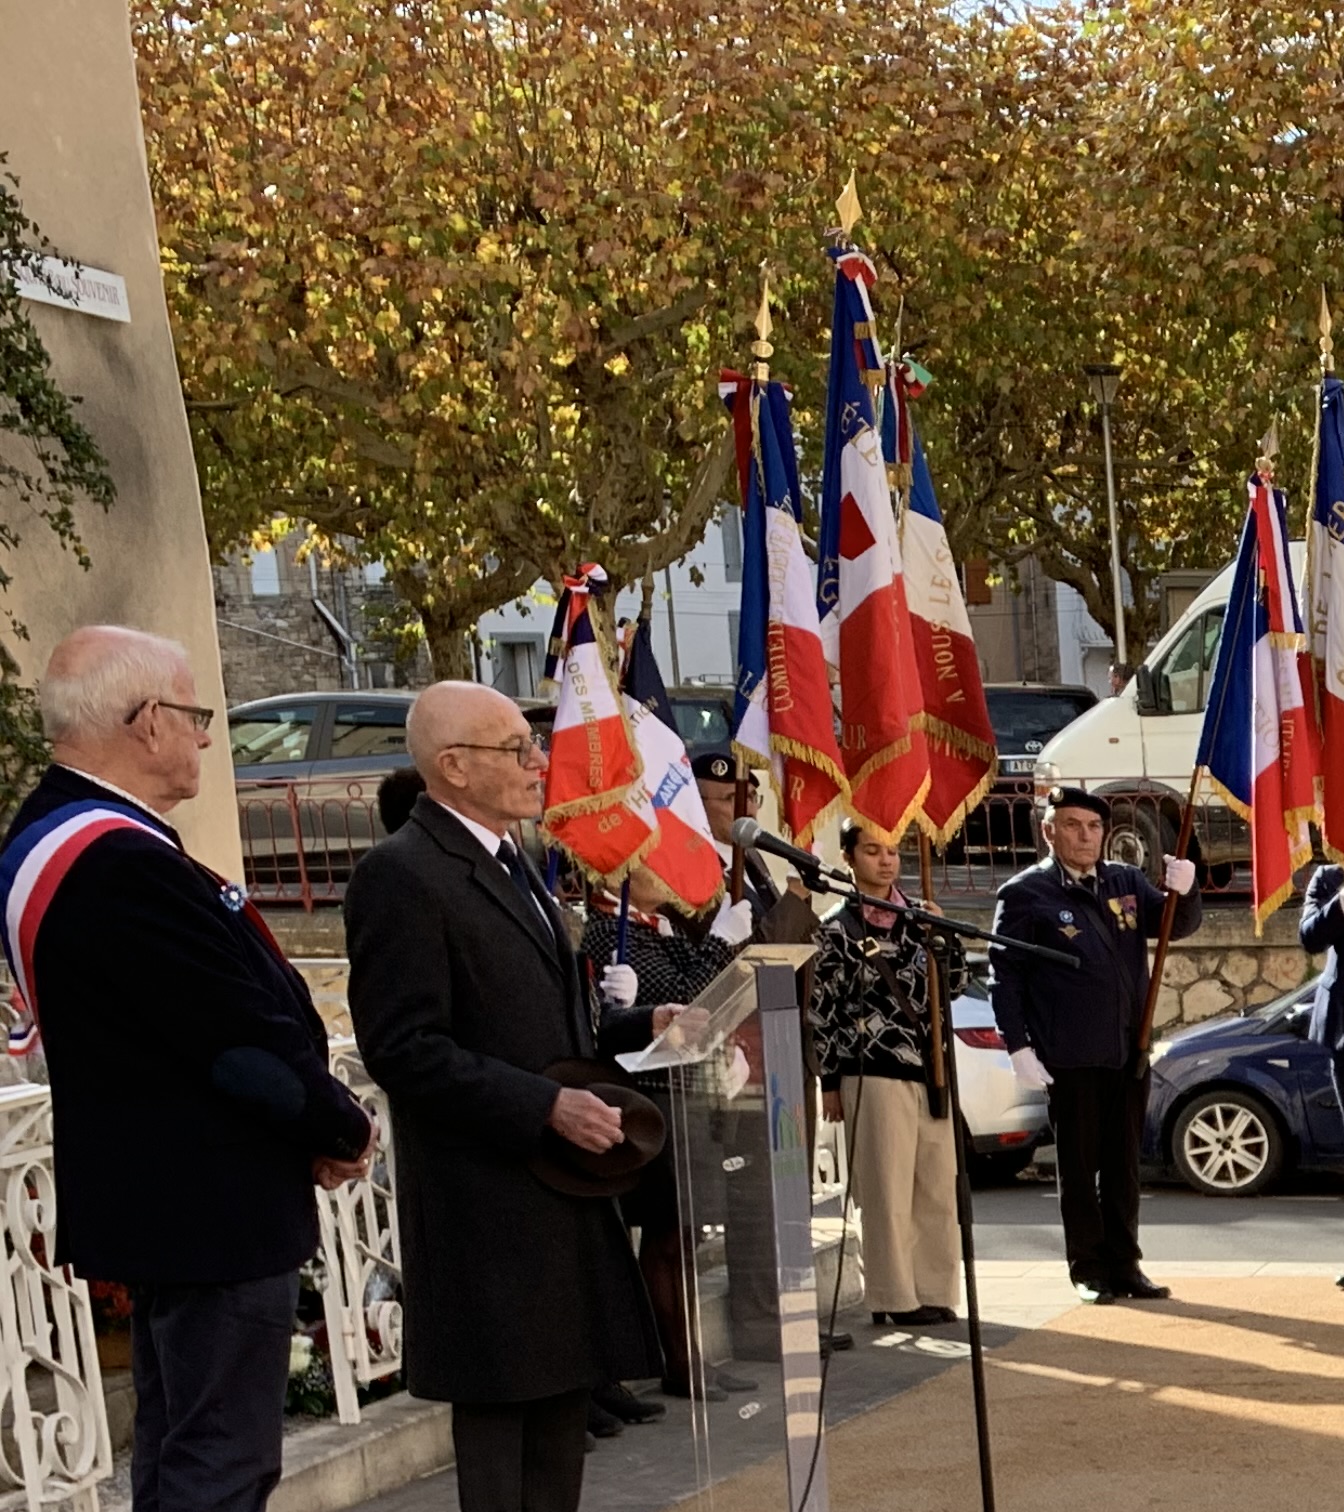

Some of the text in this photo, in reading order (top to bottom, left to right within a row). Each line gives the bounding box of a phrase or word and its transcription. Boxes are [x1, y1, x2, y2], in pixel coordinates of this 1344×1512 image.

[70, 276, 120, 305] SOUVENIR
[928, 576, 952, 606] LE
[930, 617, 958, 681] NOUS
[567, 660, 588, 697] DES
[579, 700, 603, 789] MEMBRES
